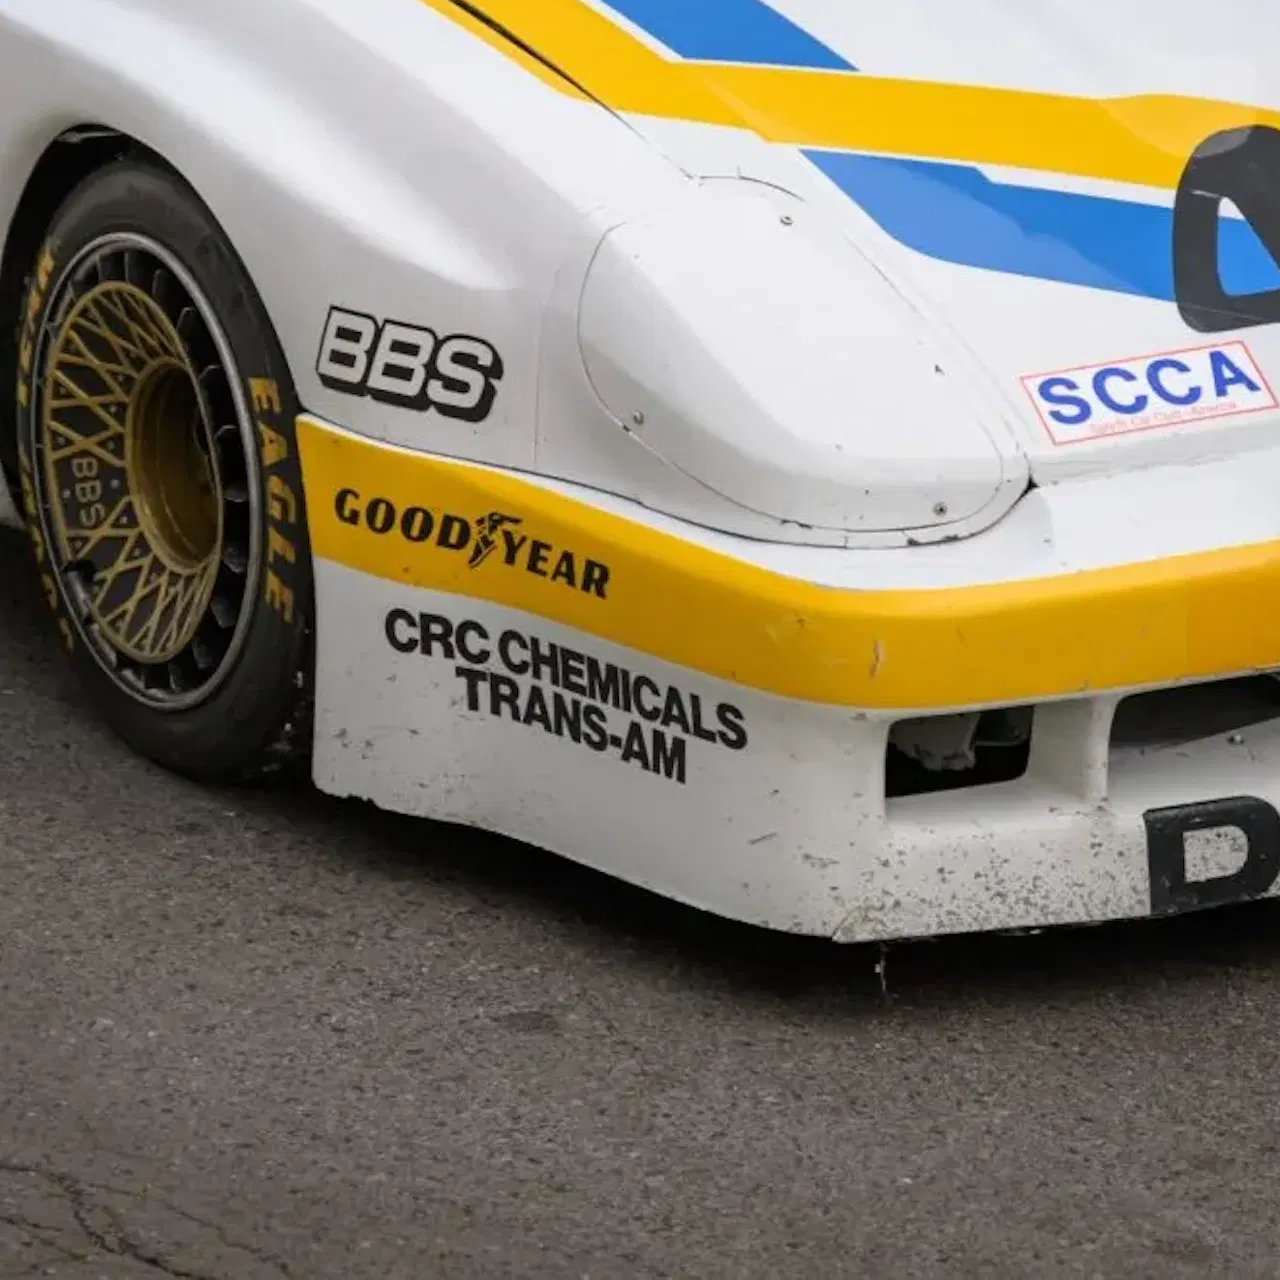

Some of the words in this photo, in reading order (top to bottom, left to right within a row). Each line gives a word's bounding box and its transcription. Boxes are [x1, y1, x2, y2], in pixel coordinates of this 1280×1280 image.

[315, 304, 504, 423] BBS
[1037, 349, 1262, 426] SCCA
[70, 454, 106, 528] BBS
[247, 376, 297, 624] EAGLE
[384, 607, 490, 665] CRC
[498, 629, 749, 751] CHEMICALS
[455, 665, 688, 785] TRANS-AM
